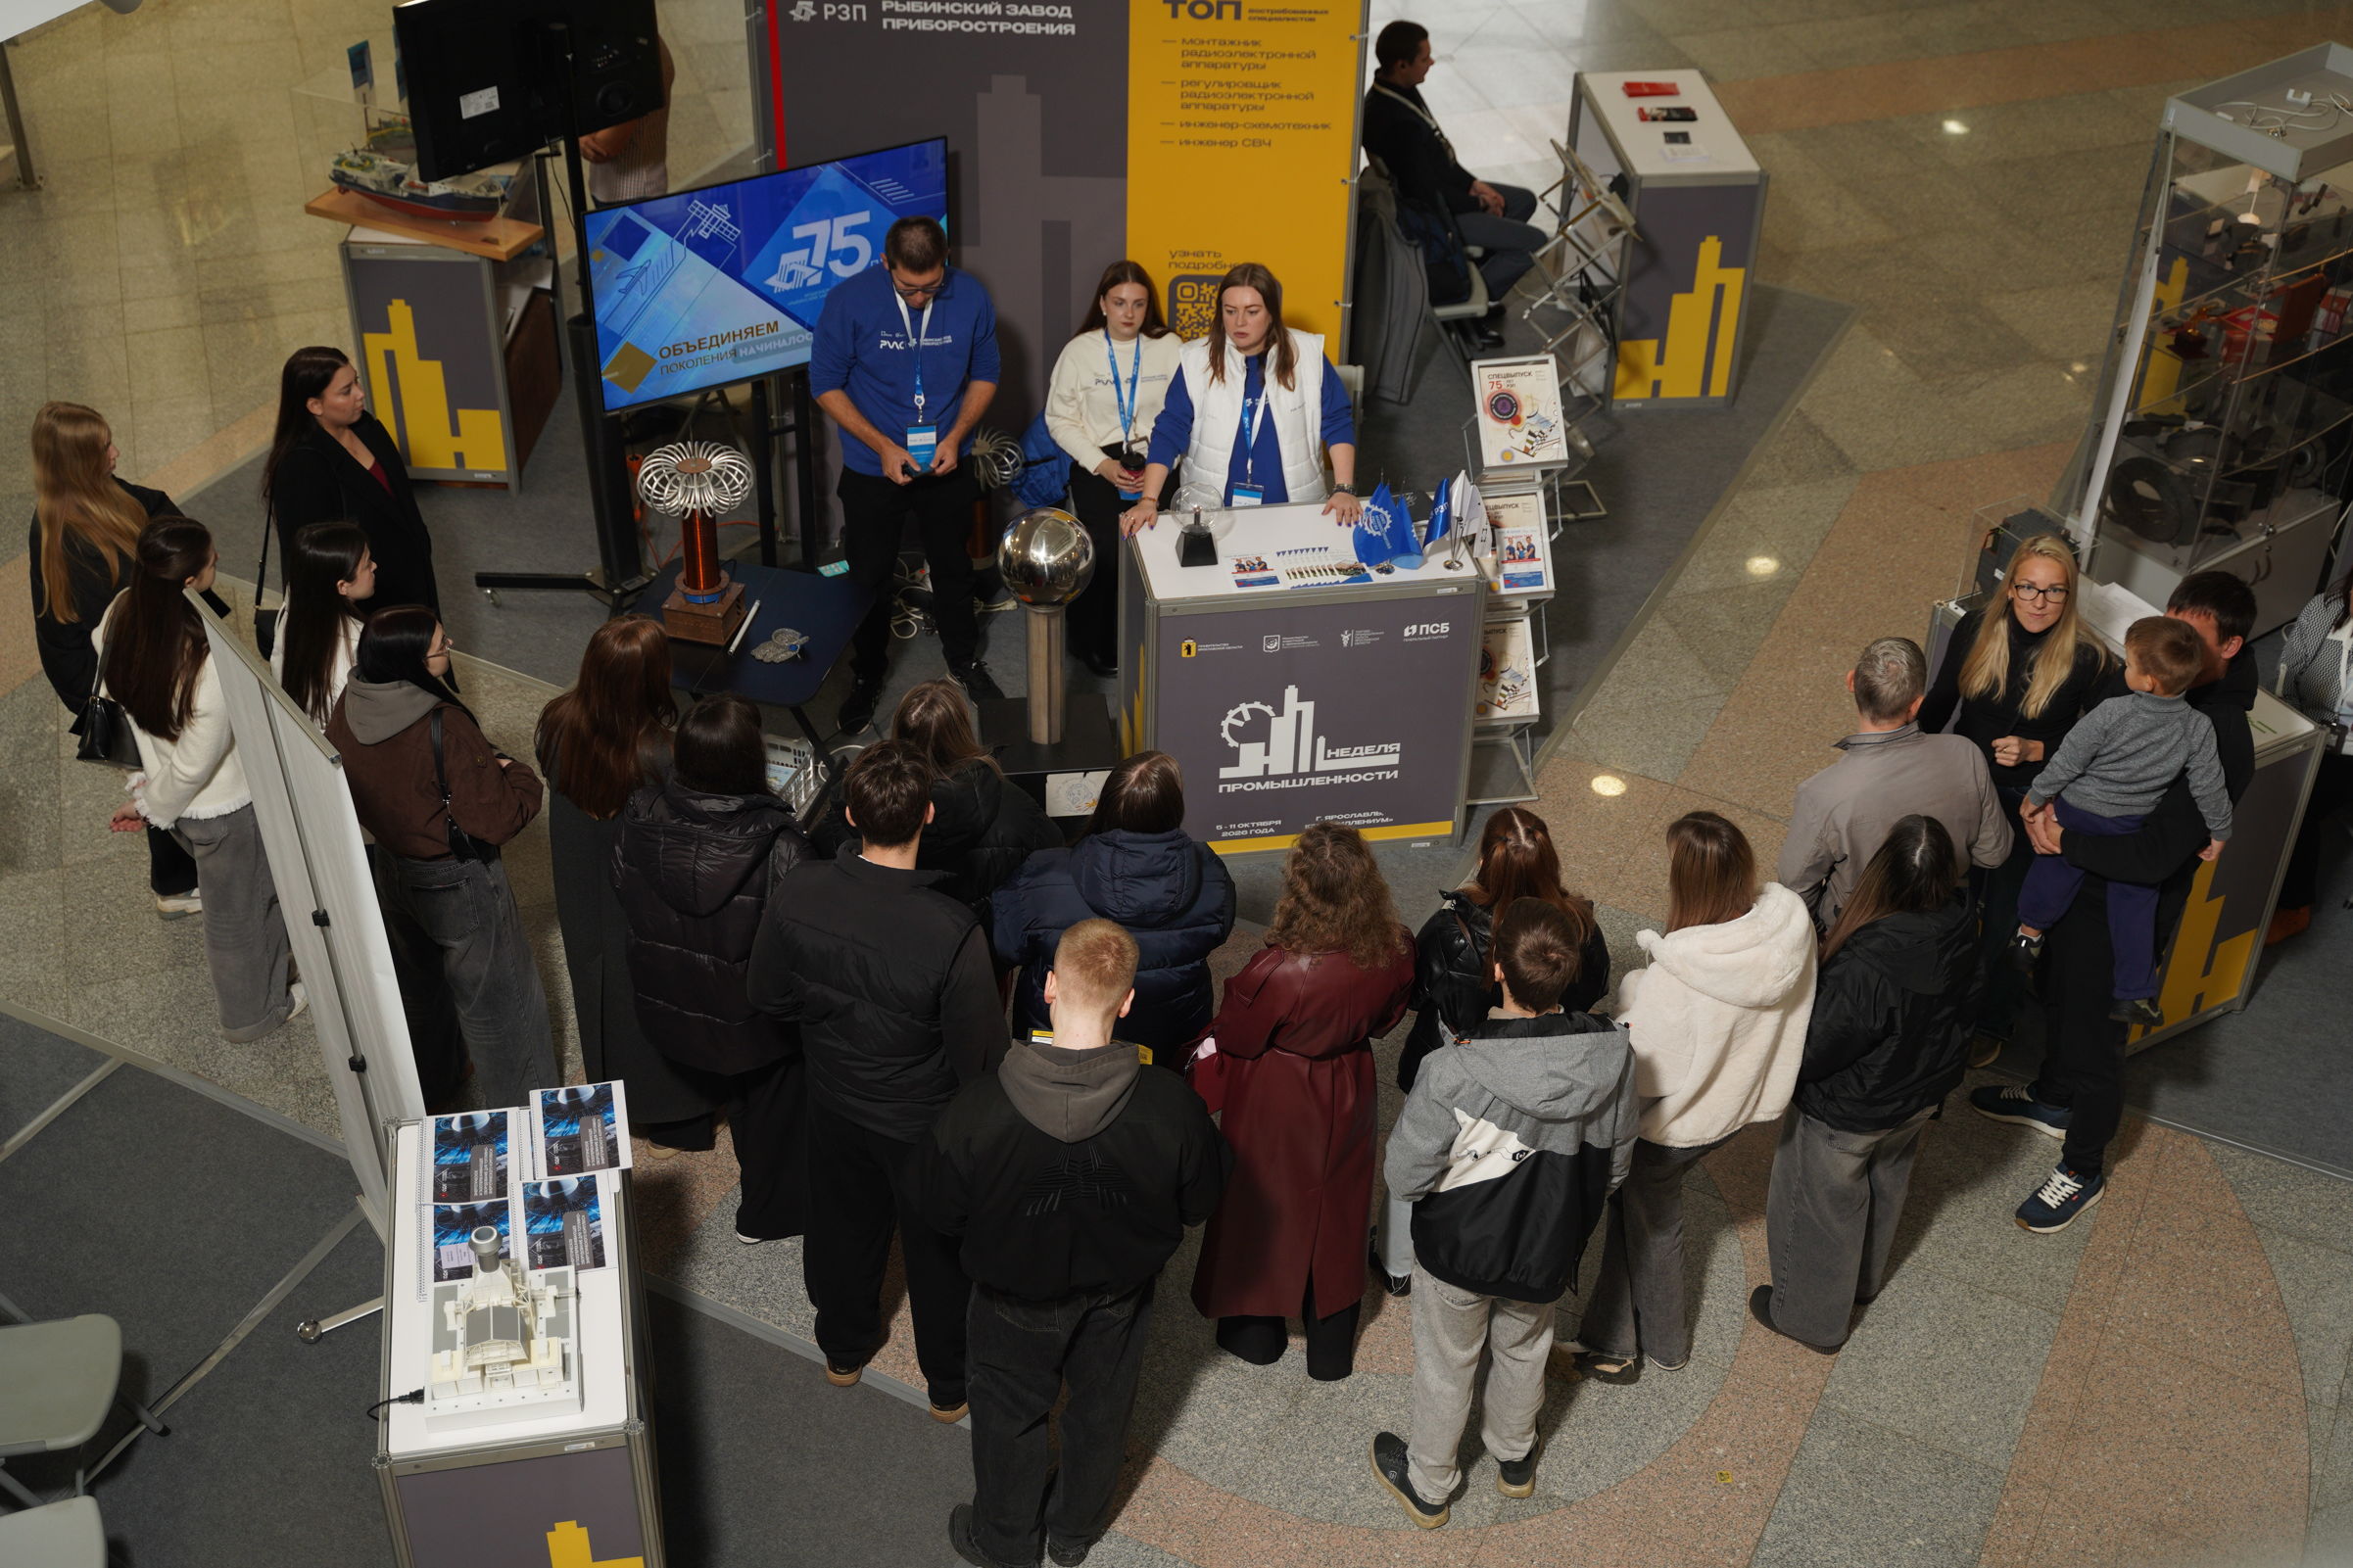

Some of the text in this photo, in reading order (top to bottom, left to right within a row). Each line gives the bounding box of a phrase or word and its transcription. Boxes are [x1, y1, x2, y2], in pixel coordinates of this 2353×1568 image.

[824, 5, 867, 21] РЗП
[883, 1, 1073, 19] РЫБИНСКИЙ ЗАВОД
[1163, 0, 1242, 21] ТОП
[883, 18, 1076, 35] ПРИБОРОСТРОЕНИЯ
[1181, 38, 1262, 47] монтажник
[1181, 49, 1317, 60] радиоэлектронной
[1181, 61, 1267, 71] аппаратуры
[1180, 79, 1281, 89] регулировщик
[1180, 91, 1315, 101] радиоэлектронной
[1180, 102, 1266, 113] аппаратуры
[1179, 120, 1332, 130] инженер-схемотехник
[1178, 138, 1272, 148] инженер СВЧ
[792, 210, 872, 278] 75
[1169, 250, 1223, 259] узнать
[1169, 261, 1240, 270] подробн
[659, 320, 780, 359] ОБЪЕДИНЯЕМ
[739, 332, 814, 358] НАЧИНАЛОС
[660, 348, 738, 376] ПОКОЛЕНИЯ
[1488, 371, 1532, 380] СПЕЦВЫПУСК
[1489, 381, 1503, 390] 75
[1419, 622, 1450, 636] ПСБ
[1326, 742, 1401, 759] НЕДЕЛЯ
[1218, 770, 1399, 793] ПРОМЫШЛЕННОСТИ
[1324, 811, 1383, 821] ЯРОСЛАВЛЬ,
[1237, 820, 1281, 829] ОКТЯБРЯ
